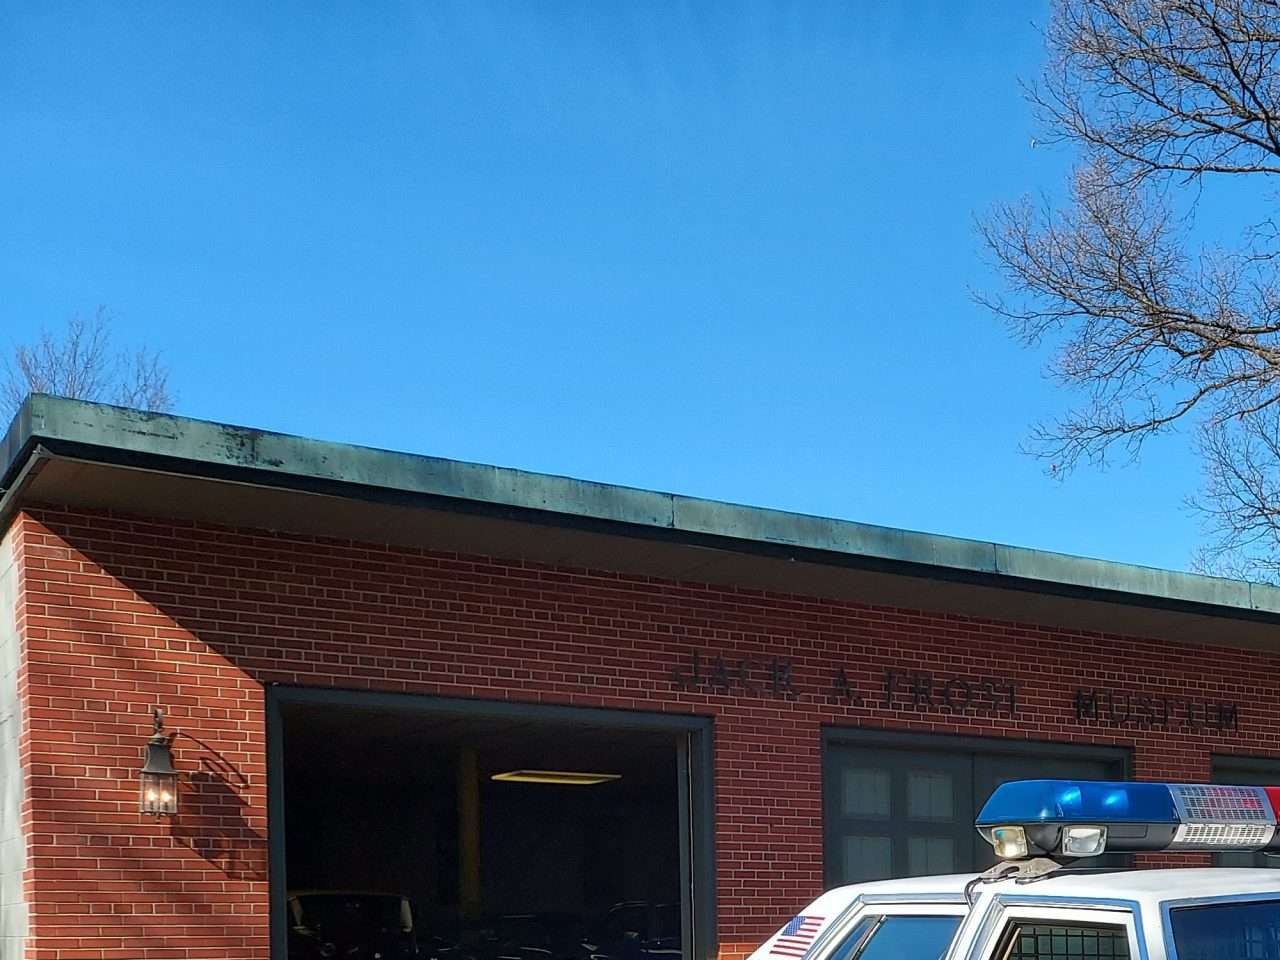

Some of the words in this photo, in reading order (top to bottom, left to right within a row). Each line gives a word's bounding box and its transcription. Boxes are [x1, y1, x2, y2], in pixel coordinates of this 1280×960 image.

[673, 649, 800, 698] JACK
[883, 664, 1022, 718] FROST
[1073, 688, 1238, 733] MUSEUM
